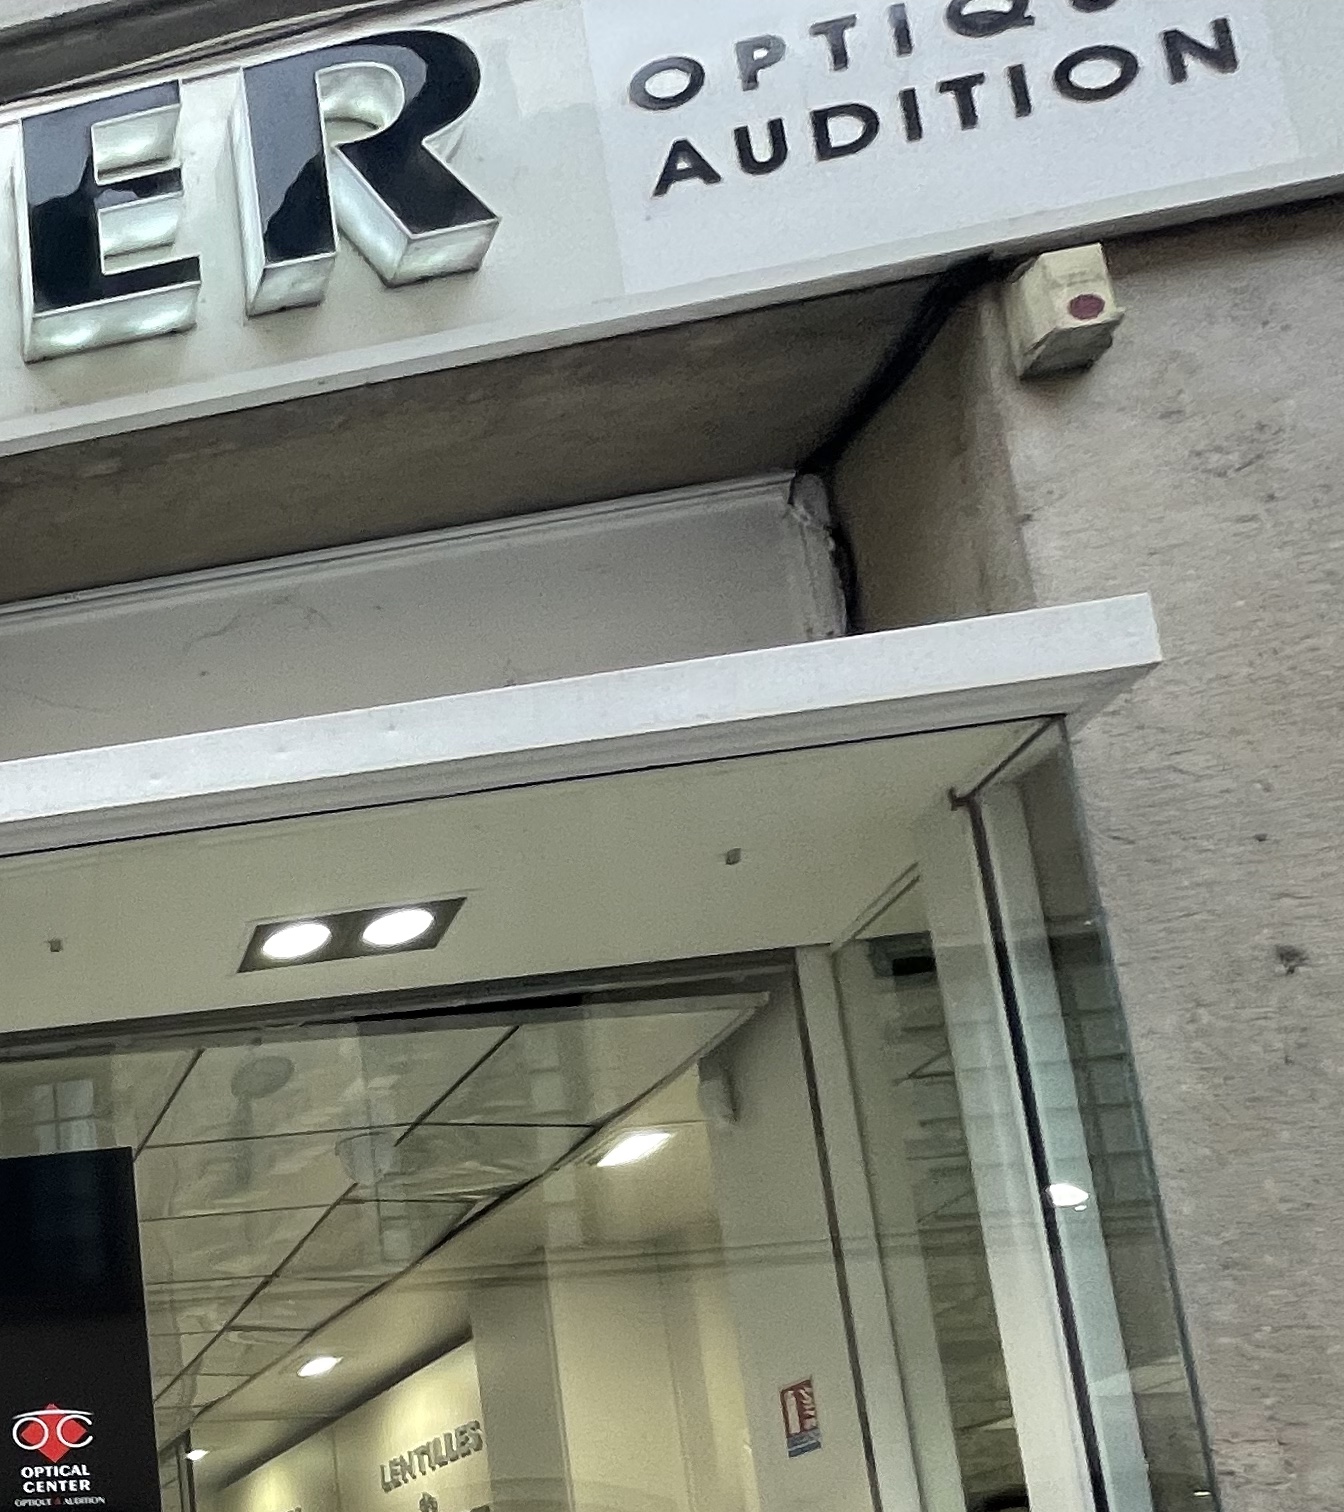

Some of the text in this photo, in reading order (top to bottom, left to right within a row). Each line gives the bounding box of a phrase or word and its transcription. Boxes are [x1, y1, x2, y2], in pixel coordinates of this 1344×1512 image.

[629, 0, 1115, 112] OPTIQ
[651, 18, 1241, 198] AUDITION
[21, 1464, 90, 1479] OPTICAL
[23, 1479, 91, 1493] CENTER
[380, 1420, 483, 1493] LENTILLES
